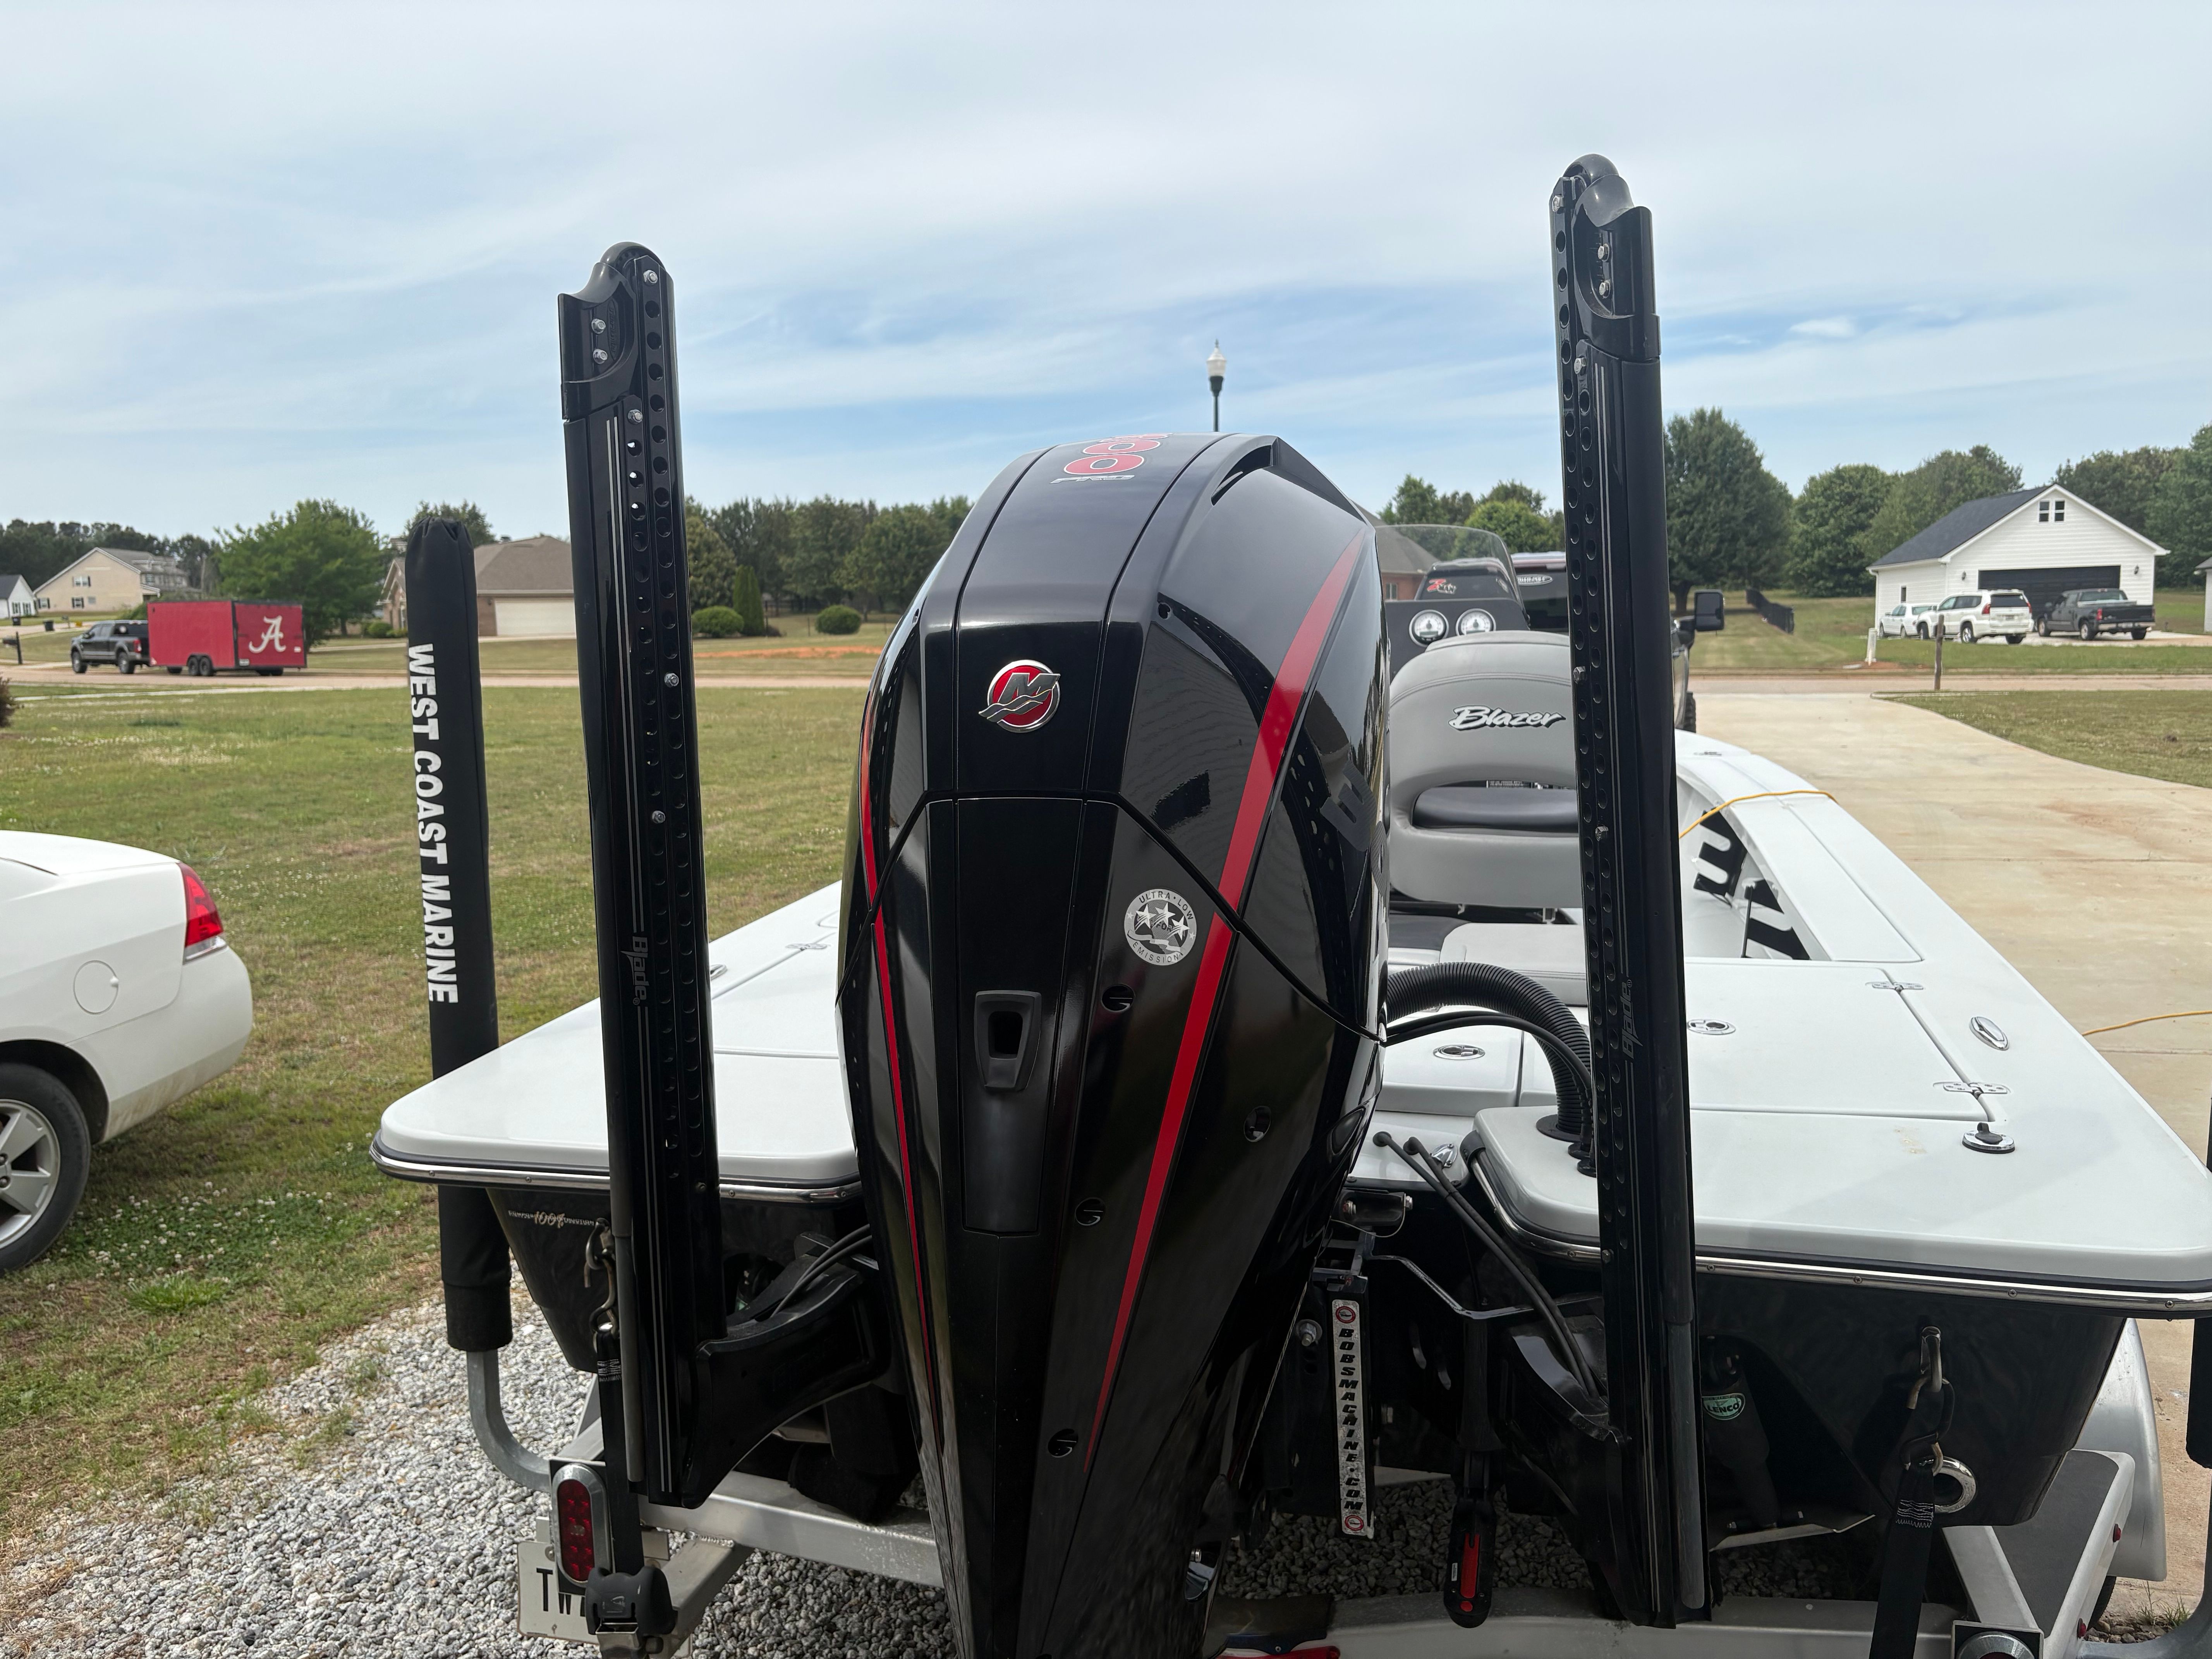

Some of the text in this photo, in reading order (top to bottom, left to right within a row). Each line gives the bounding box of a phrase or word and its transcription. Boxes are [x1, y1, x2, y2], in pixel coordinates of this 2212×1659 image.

[248, 615, 286, 654] A
[1448, 705, 1566, 731] Blazer
[408, 643, 459, 1004] WEST COAST MARINE
[1139, 891, 1194, 920] ULTRA LOW
[620, 936, 649, 1000] Blade
[1132, 941, 1179, 963] EMISSION
[1620, 982, 1643, 1059] Blade
[1707, 1402, 1740, 1413] LENCO
[536, 1568, 586, 1616] TW
